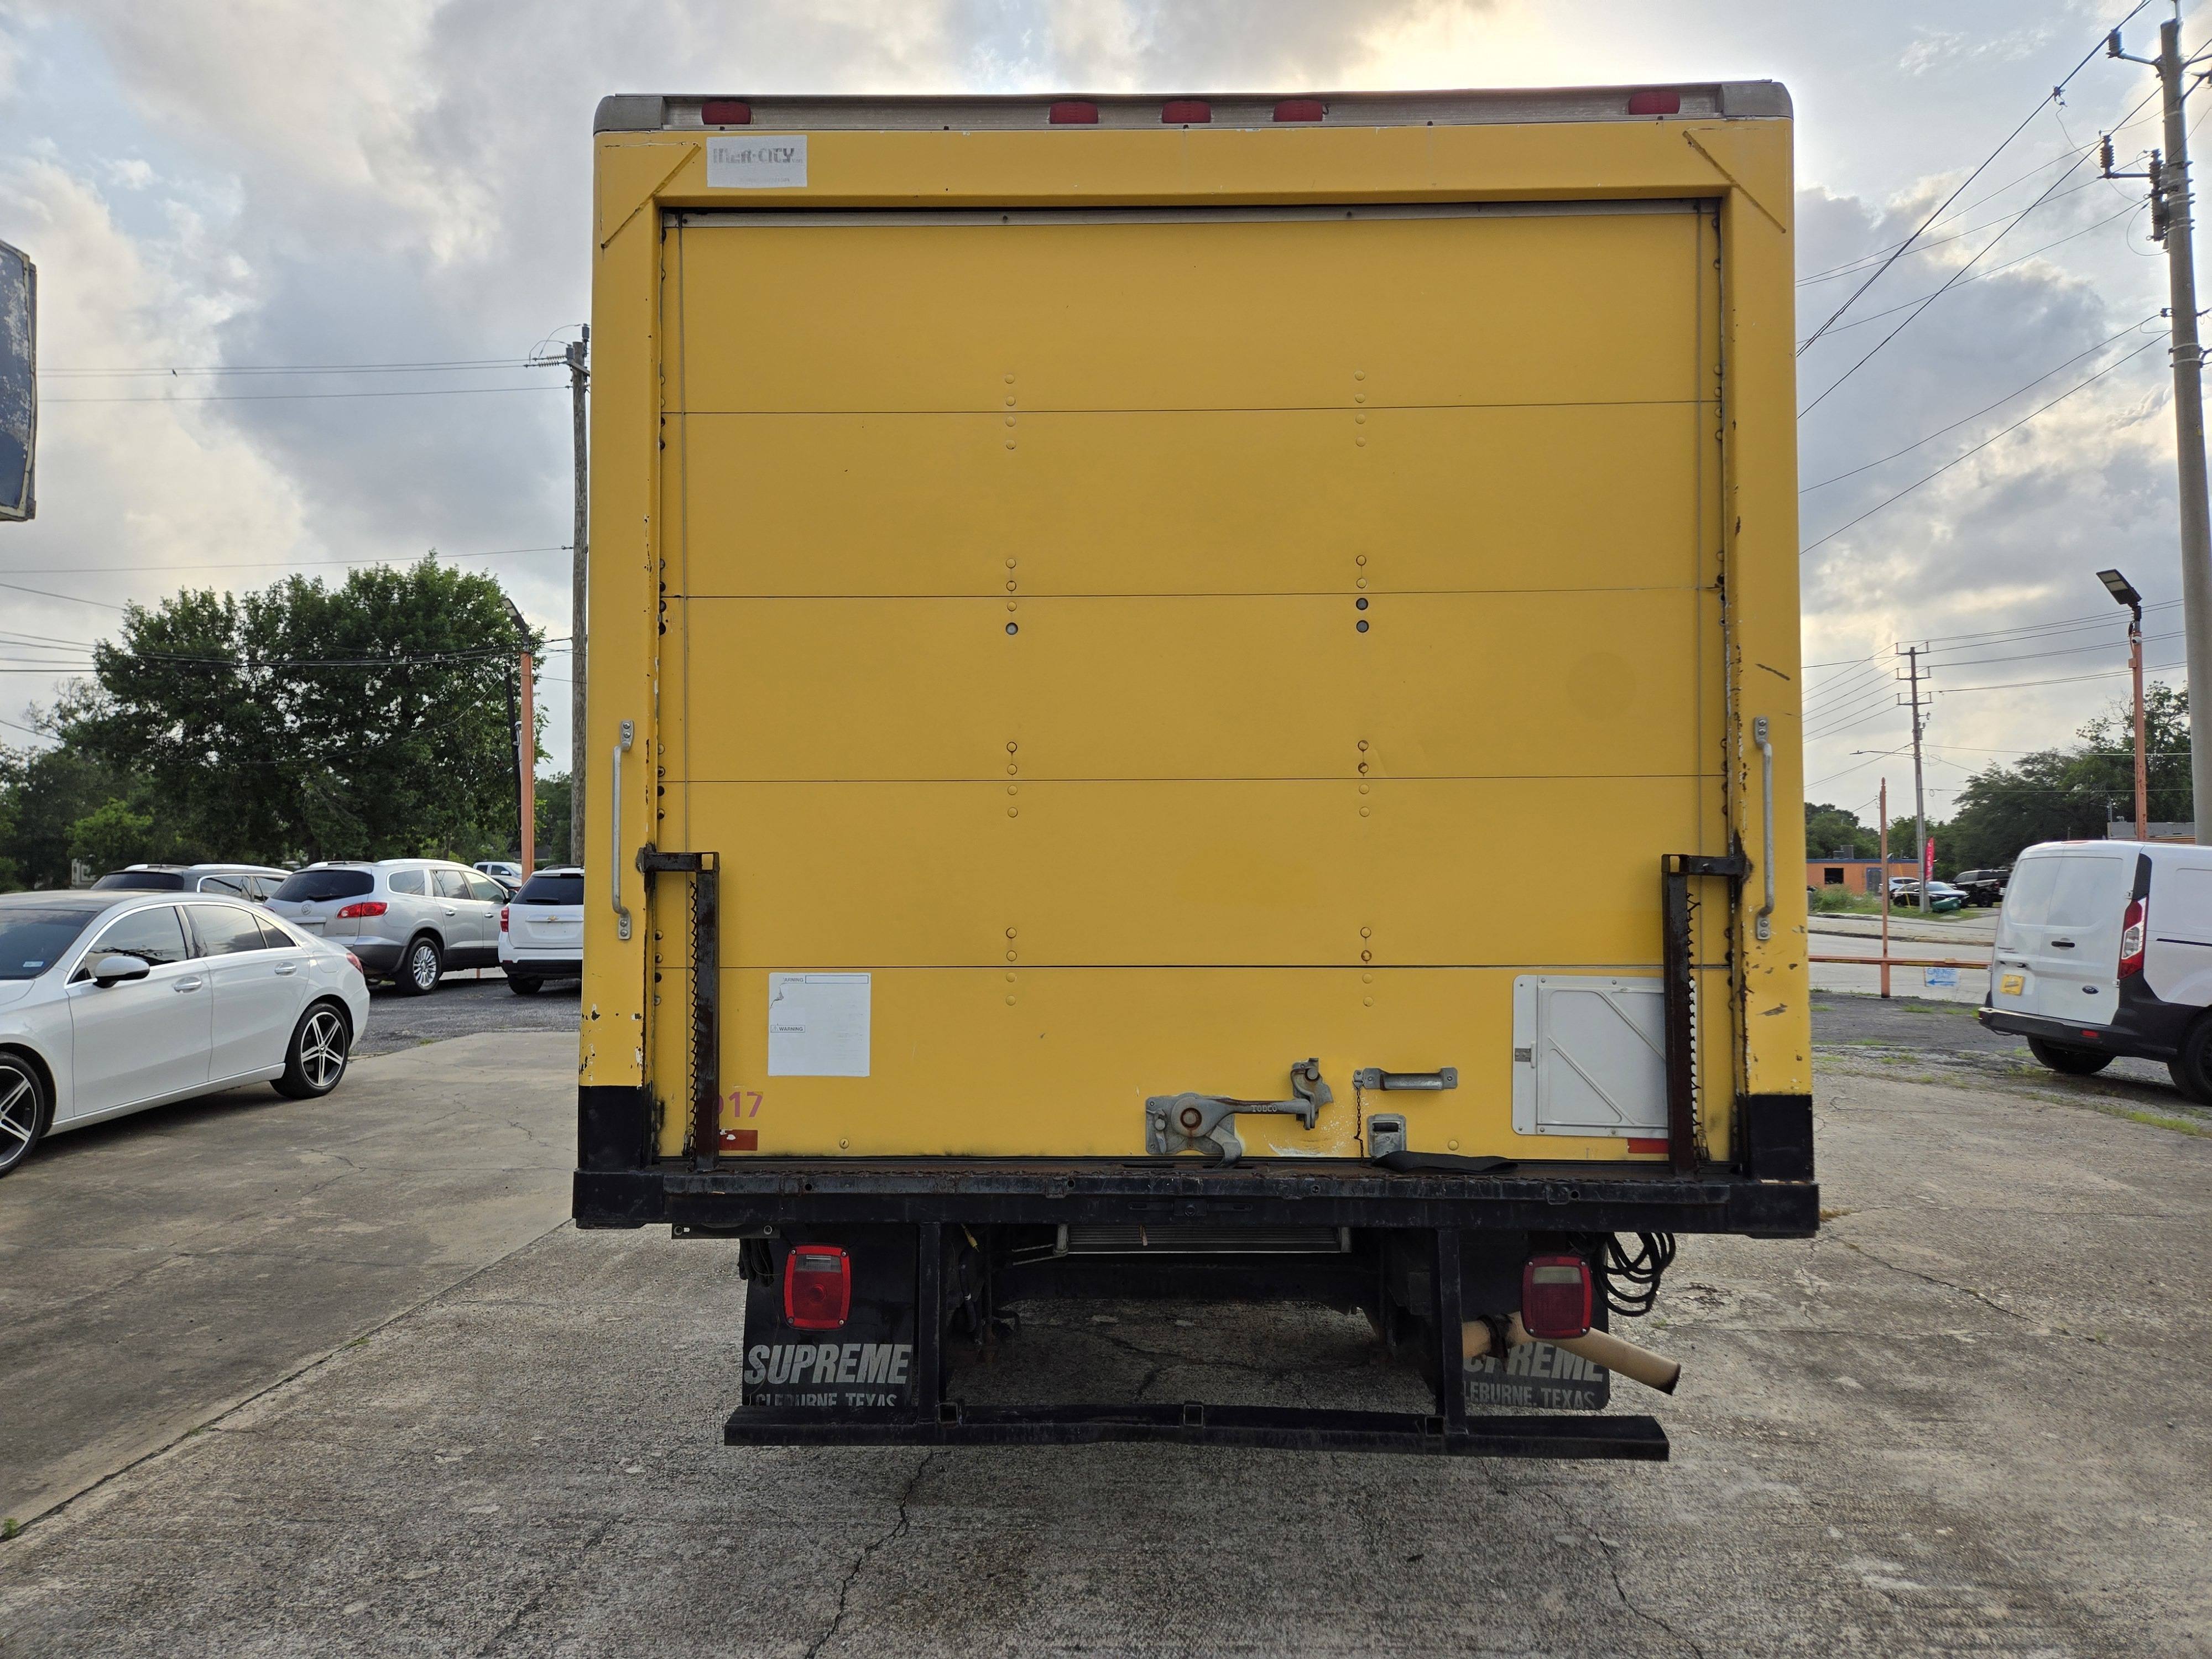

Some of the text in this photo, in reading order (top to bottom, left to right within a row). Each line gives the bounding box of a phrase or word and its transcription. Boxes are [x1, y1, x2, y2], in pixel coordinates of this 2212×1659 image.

[1251, 1104, 1277, 1113] TODCO
[744, 1343, 912, 1385] SUPREME
[845, 1393, 898, 1406] TEXAS
[1540, 1387, 1595, 1410] TEXAS
